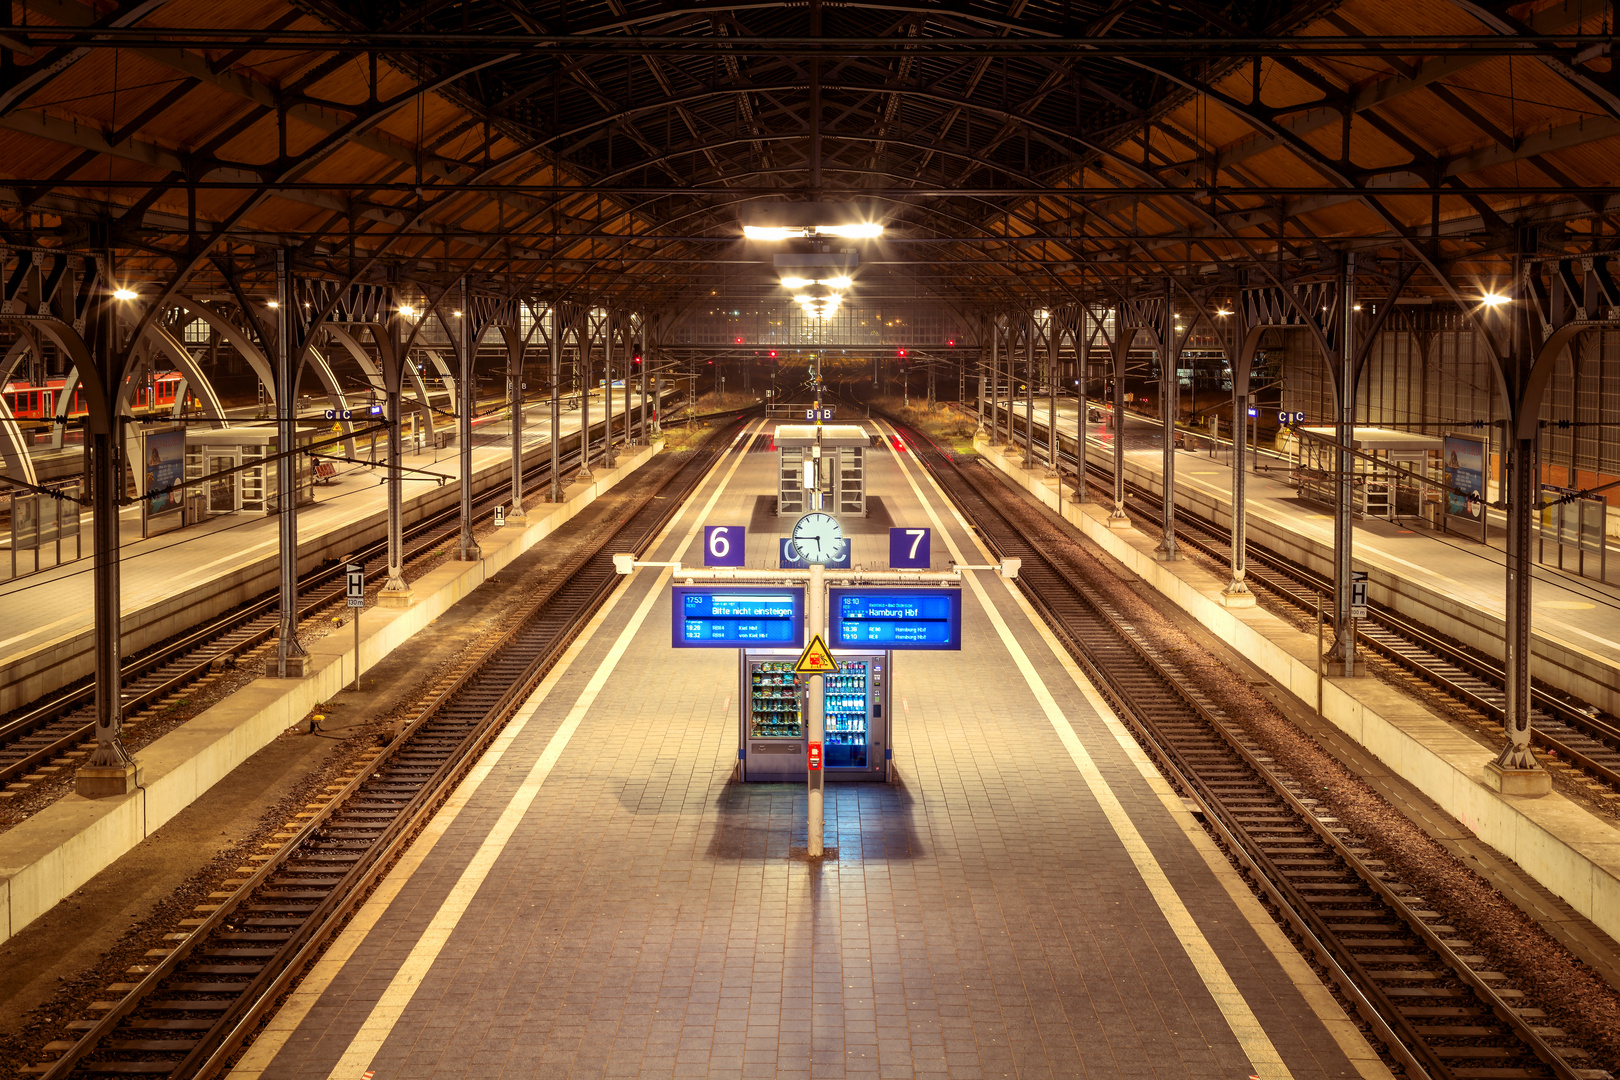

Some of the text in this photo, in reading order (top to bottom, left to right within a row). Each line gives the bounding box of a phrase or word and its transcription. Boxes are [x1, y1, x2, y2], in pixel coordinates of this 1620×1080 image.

[326, 410, 333, 419] C
[343, 410, 350, 419] C
[807, 410, 813, 418] B
[824, 410, 831, 418] B
[1279, 412, 1286, 421] C
[1296, 412, 1303, 421] C
[496, 508, 503, 518] H
[710, 527, 730, 557] 6
[906, 530, 925, 559] 7
[349, 575, 361, 594] H
[1353, 584, 1365, 604] H
[754, 607, 792, 617] einsteigen
[869, 609, 902, 618] Hamburg
